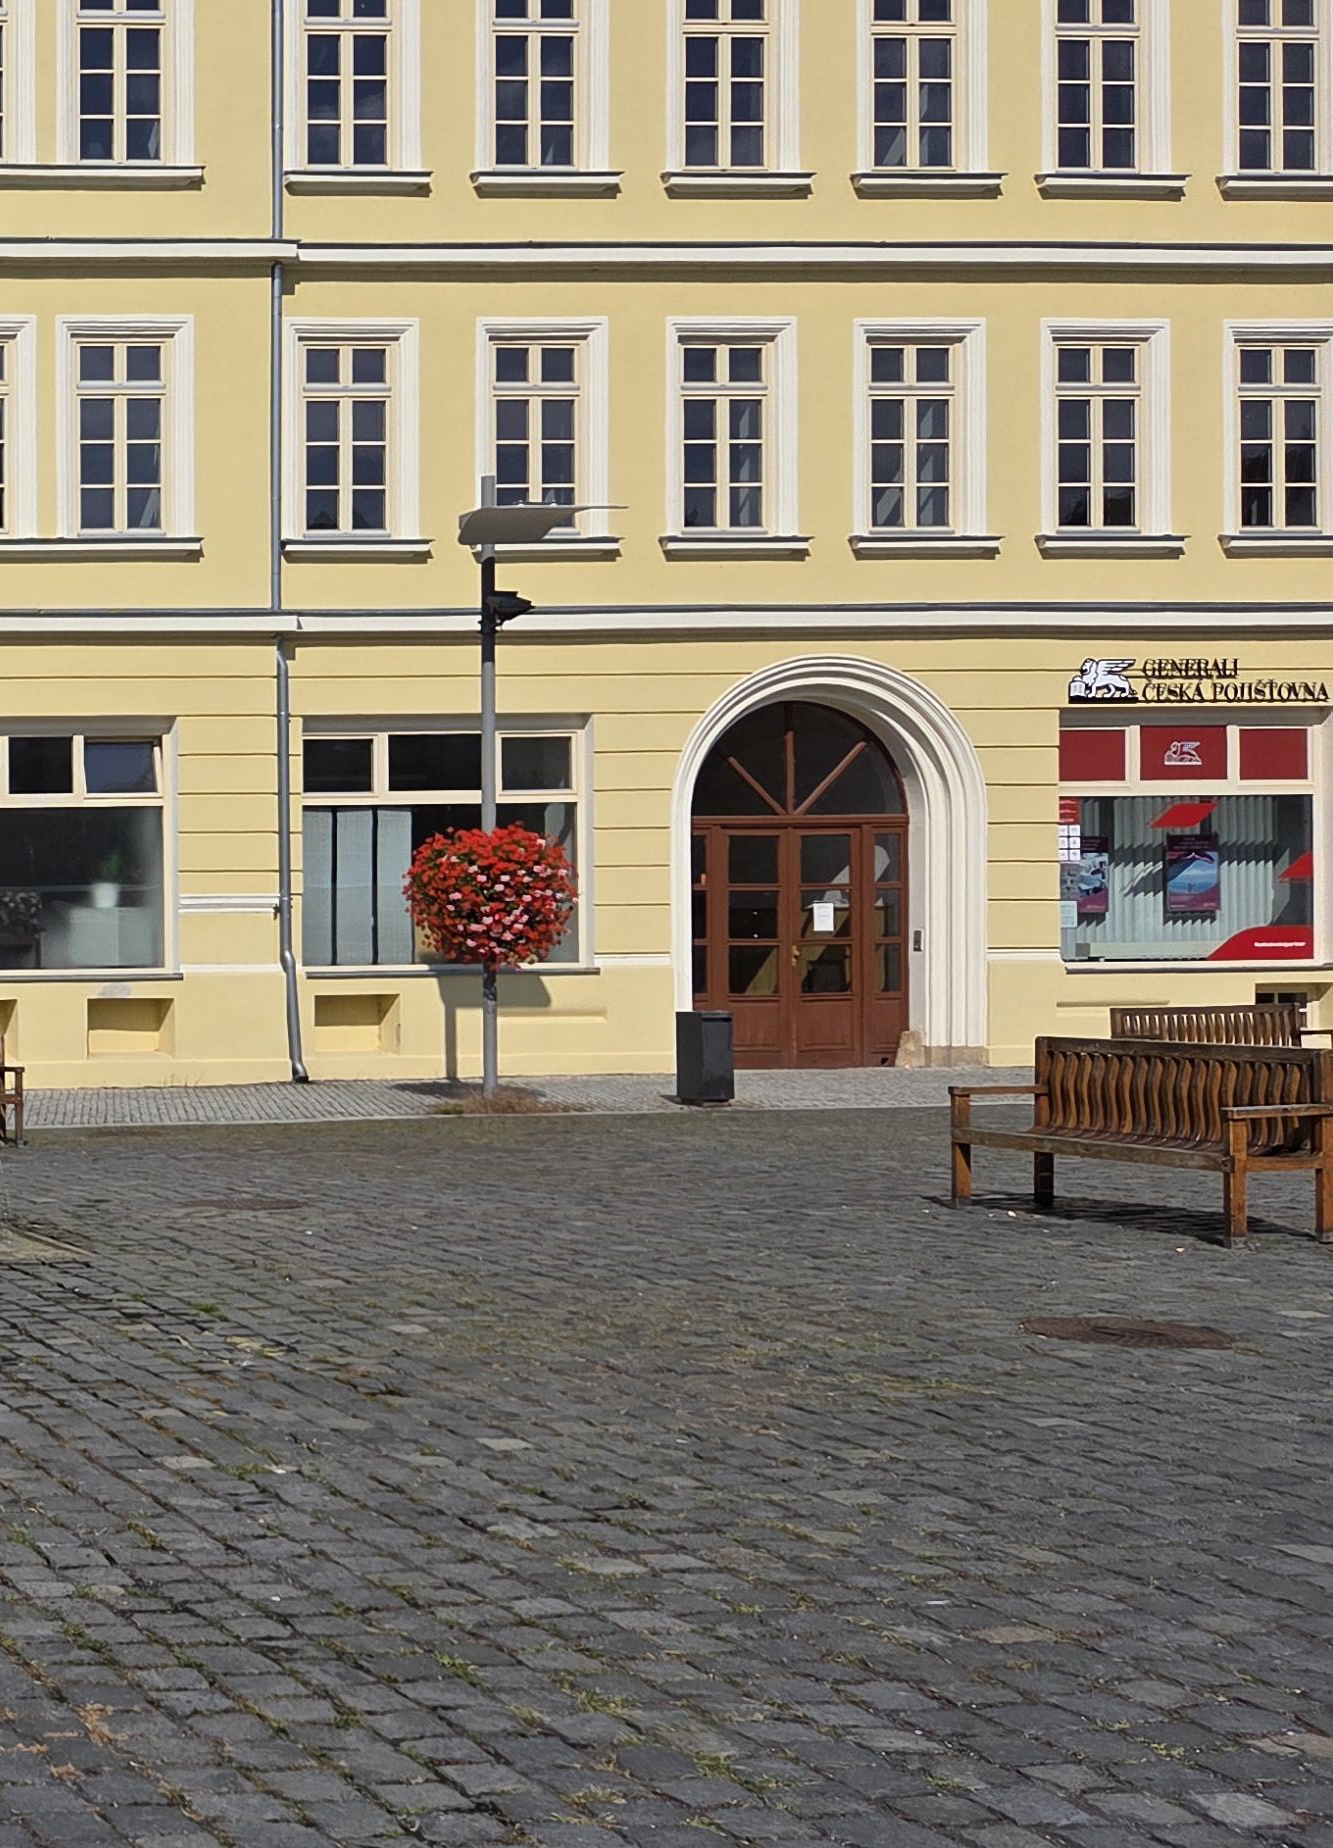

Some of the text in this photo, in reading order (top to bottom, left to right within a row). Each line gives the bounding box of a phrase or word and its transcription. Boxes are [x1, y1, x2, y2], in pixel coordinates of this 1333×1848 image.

[1142, 657, 1239, 678] GENERALI
[1142, 679, 1330, 702] ČESKÁ POJIŠŤOVNA
